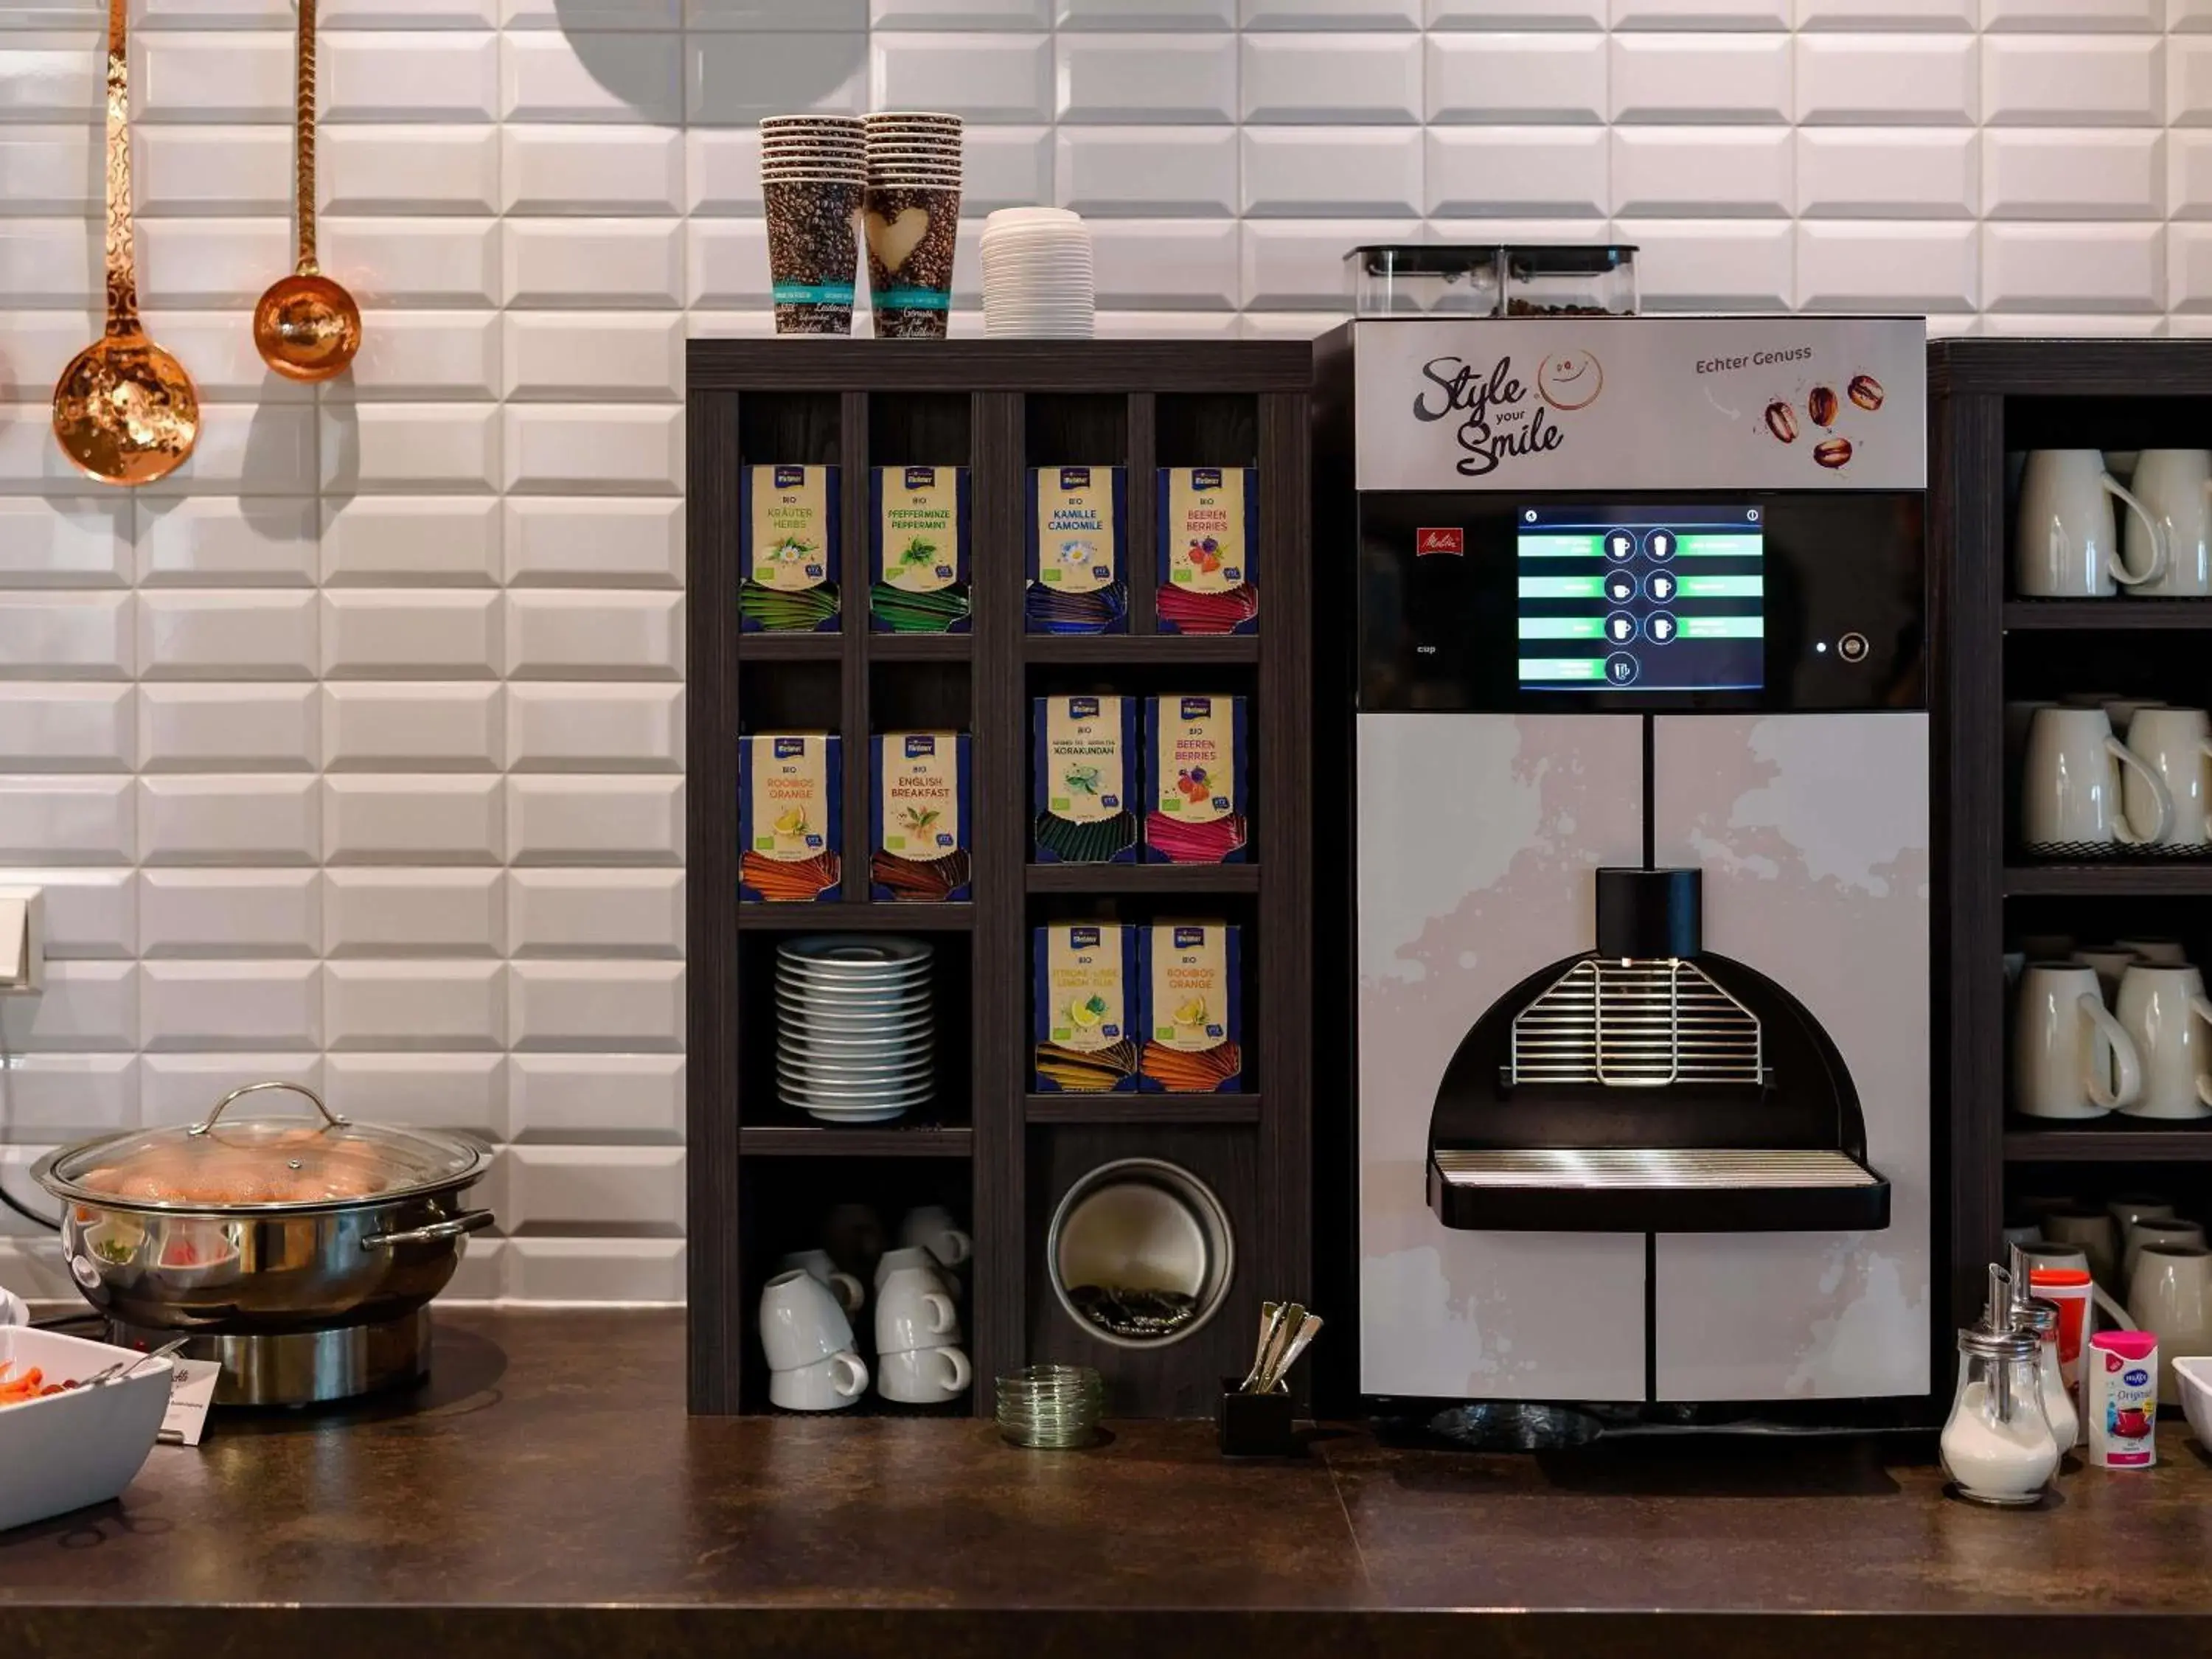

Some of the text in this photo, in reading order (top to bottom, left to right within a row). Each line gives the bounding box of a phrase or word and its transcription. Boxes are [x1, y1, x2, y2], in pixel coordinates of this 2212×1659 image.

[1696, 347, 1812, 374] Echter Genuss
[1413, 356, 1526, 422] Style
[1496, 410, 1525, 425] your
[1456, 406, 1564, 476] Smile
[1054, 509, 1096, 518] KAMILLE
[1188, 509, 1226, 519] BEEREN
[773, 519, 807, 529] HERBS
[1048, 521, 1103, 530] CAMOMILE
[1186, 521, 1228, 531] BERRIES
[1177, 740, 1215, 749] BEEREN
[1175, 751, 1217, 760] BERRIES
[899, 777, 943, 787] ENGLISH
[769, 790, 813, 799] ORANGE
[891, 788, 951, 797] BREAKFAST
[1169, 980, 1213, 989] ORANGE
